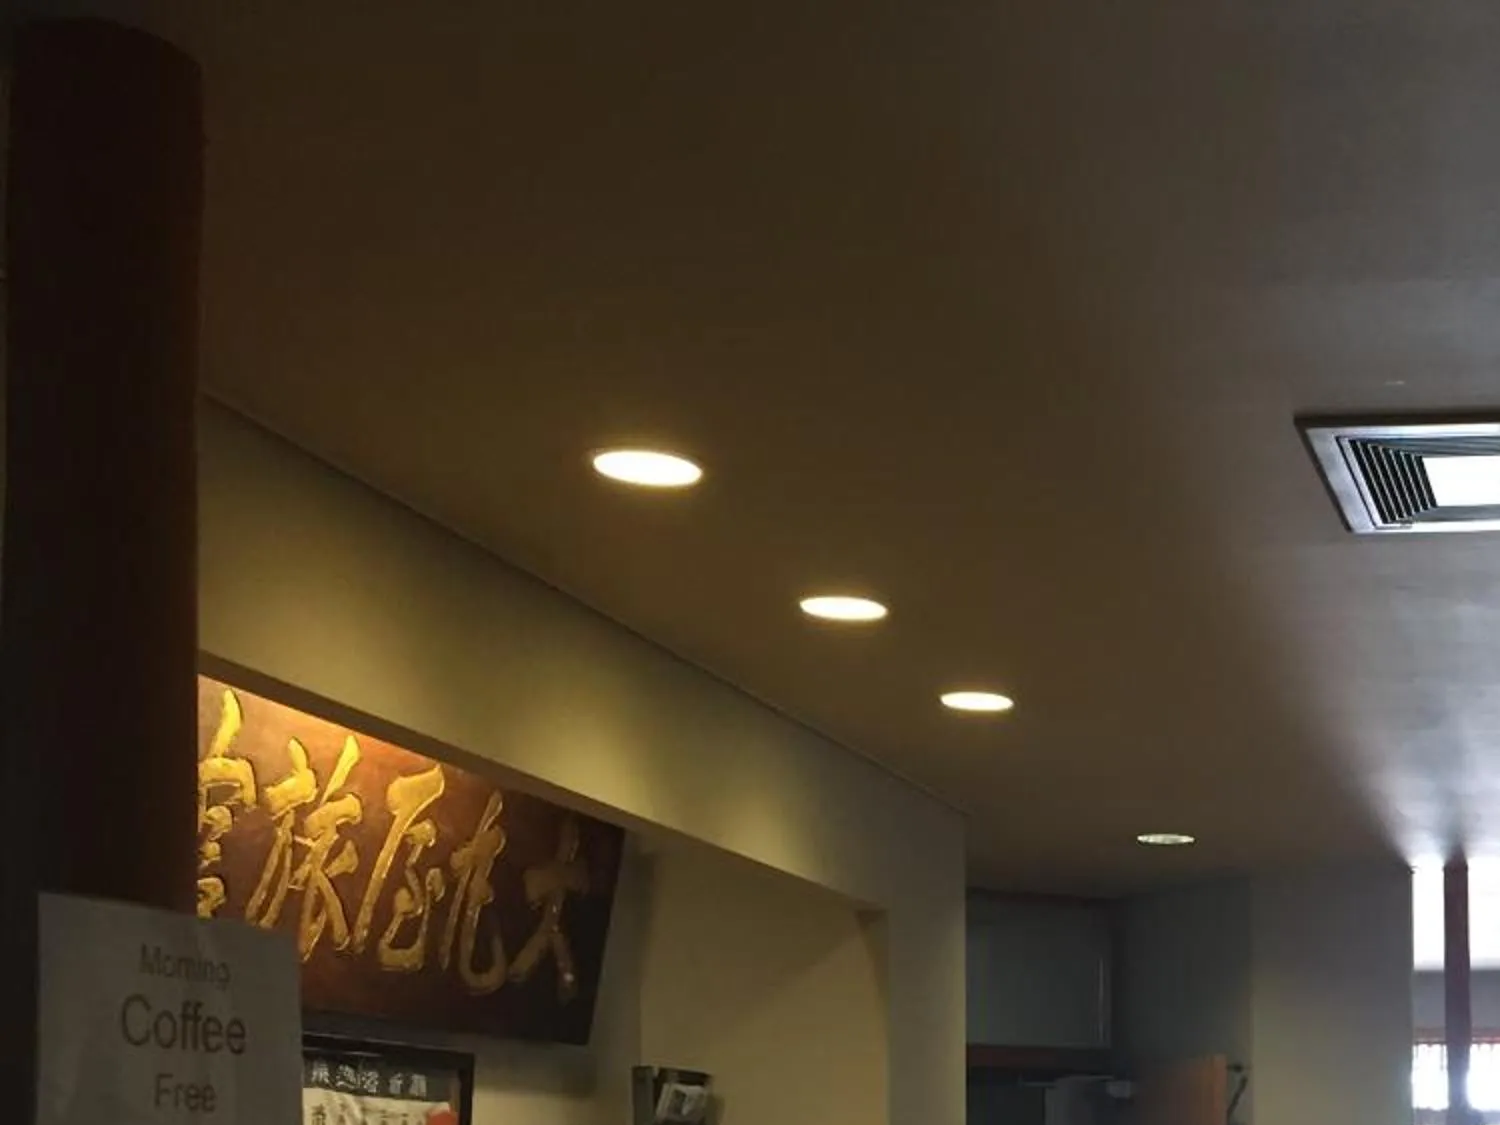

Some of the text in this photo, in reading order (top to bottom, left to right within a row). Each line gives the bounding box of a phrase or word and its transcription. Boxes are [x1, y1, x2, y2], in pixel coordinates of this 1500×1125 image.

[140, 942, 231, 991] Morning
[120, 992, 248, 1056] Coffee
[153, 1072, 218, 1114] Free
